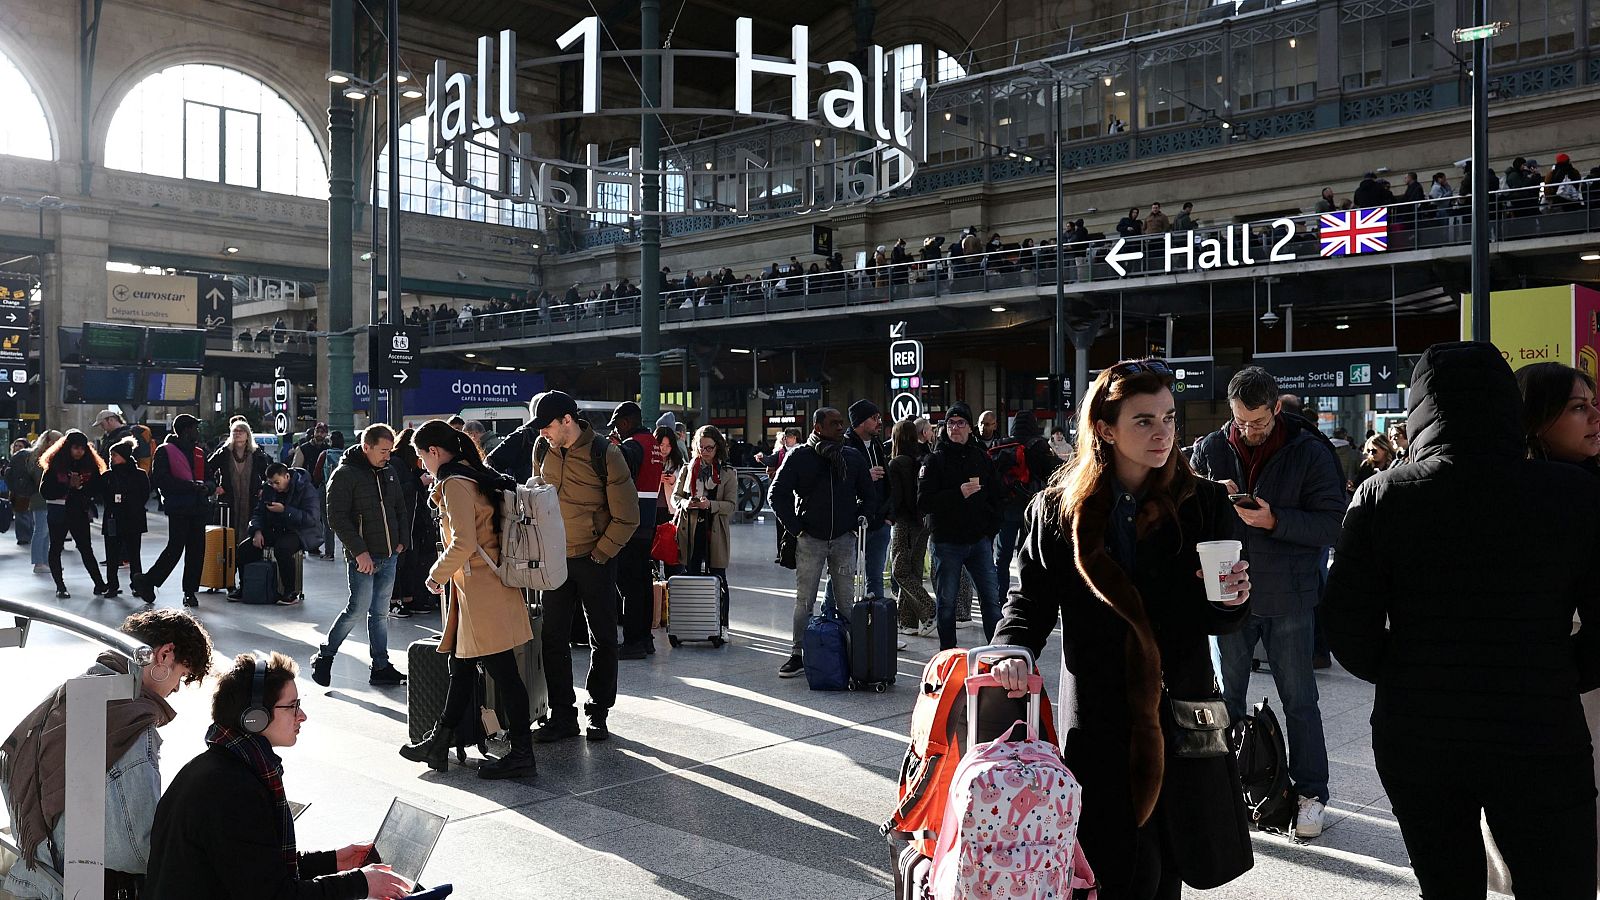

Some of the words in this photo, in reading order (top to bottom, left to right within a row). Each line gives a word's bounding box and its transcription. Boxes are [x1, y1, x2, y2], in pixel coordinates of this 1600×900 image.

[426, 29, 524, 161] Hall
[556, 16, 600, 114] 1
[736, 17, 908, 147] Hall
[1164, 223, 1255, 272] Hall
[1269, 218, 1296, 262] 2
[133, 289, 186, 302] eurostar
[141, 309, 169, 318] Londres
[894, 351, 915, 365] RER
[1519, 344, 1549, 359] taxi
[1273, 375, 1305, 383] Esplanade
[1308, 371, 1335, 381] Sortie
[452, 379, 518, 396] donnant
[898, 400, 913, 421] M
